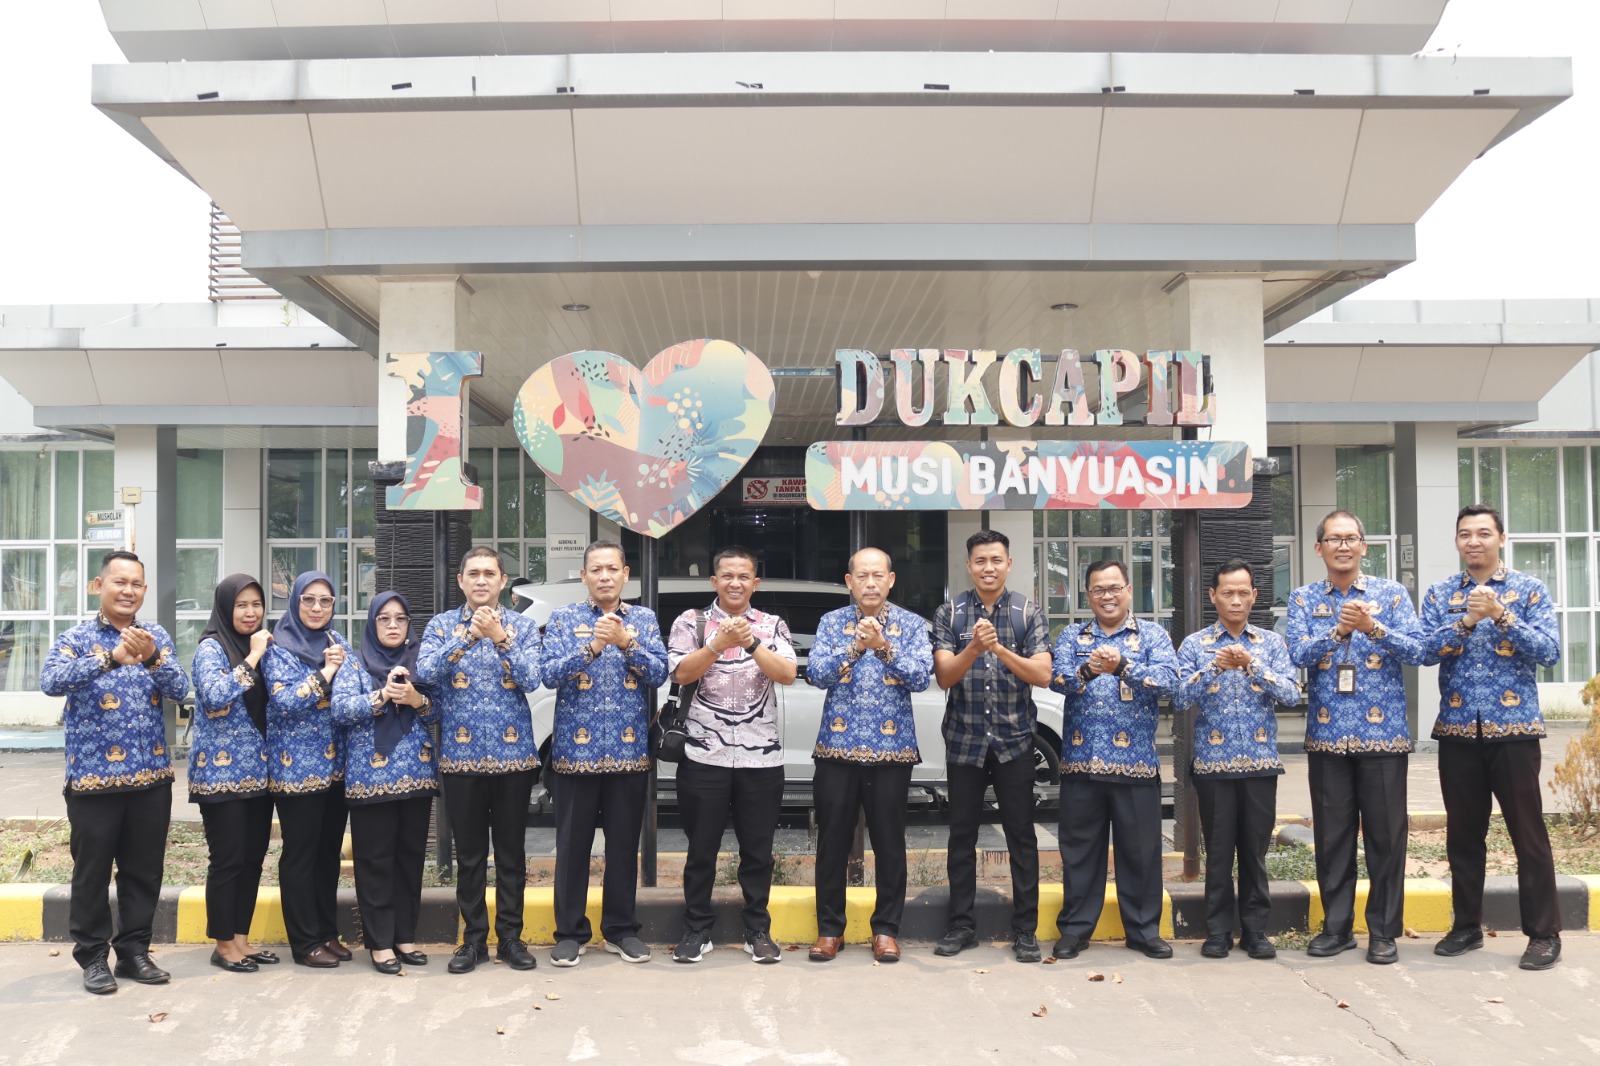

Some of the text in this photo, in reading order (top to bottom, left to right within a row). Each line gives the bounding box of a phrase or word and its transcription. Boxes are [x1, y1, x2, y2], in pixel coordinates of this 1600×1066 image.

[835, 349, 1217, 428] DUKCAPIL
[386, 352, 483, 511] I
[840, 455, 1219, 496] MUSI BANYUASIN
